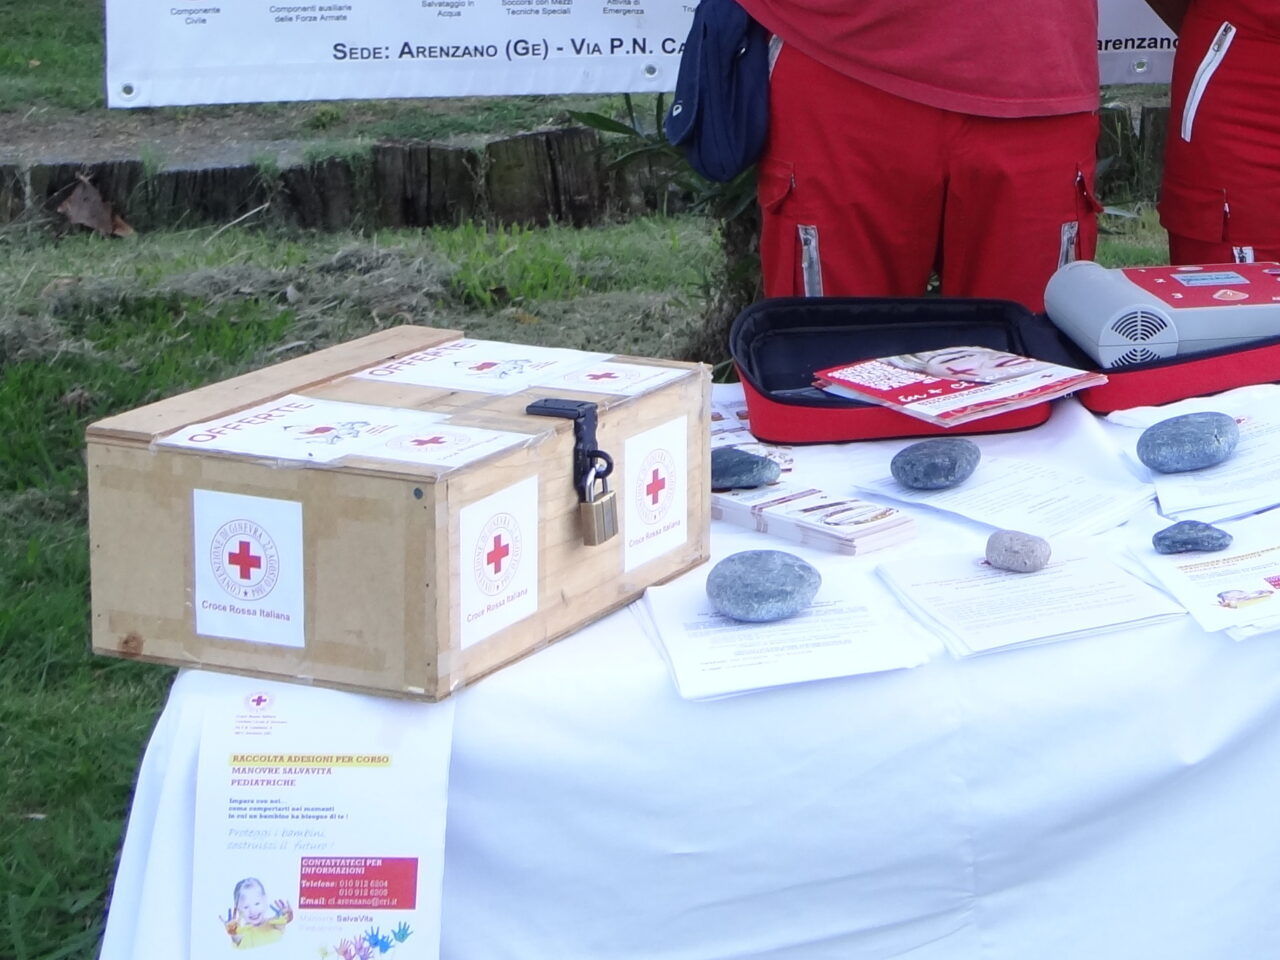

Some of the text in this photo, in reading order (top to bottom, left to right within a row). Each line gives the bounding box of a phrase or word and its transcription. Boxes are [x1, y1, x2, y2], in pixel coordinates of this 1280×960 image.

[421, 0, 466, 9] Salvataggio
[170, 7, 221, 16] Componente
[437, 10, 462, 18] Acqua
[506, 8, 571, 16] Tecniche Speciali
[603, 8, 645, 17] Emergenza
[185, 17, 207, 25] Civile
[333, 42, 390, 60] SEDE:
[398, 41, 498, 59] ARENZANO
[505, 39, 549, 61] (GE)
[570, 38, 603, 56] VIA
[610, 37, 654, 55] P.N.
[368, 343, 478, 377] OFFERTE
[188, 402, 315, 443] OFFERTE
[202, 600, 291, 622] Croce Rossa Italiana
[232, 755, 389, 764] RACCOLTA ADESIONI PER CORSO
[231, 767, 332, 775] MANOVRE SALVAVITA
[231, 778, 296, 787] PEDIATRICHE
